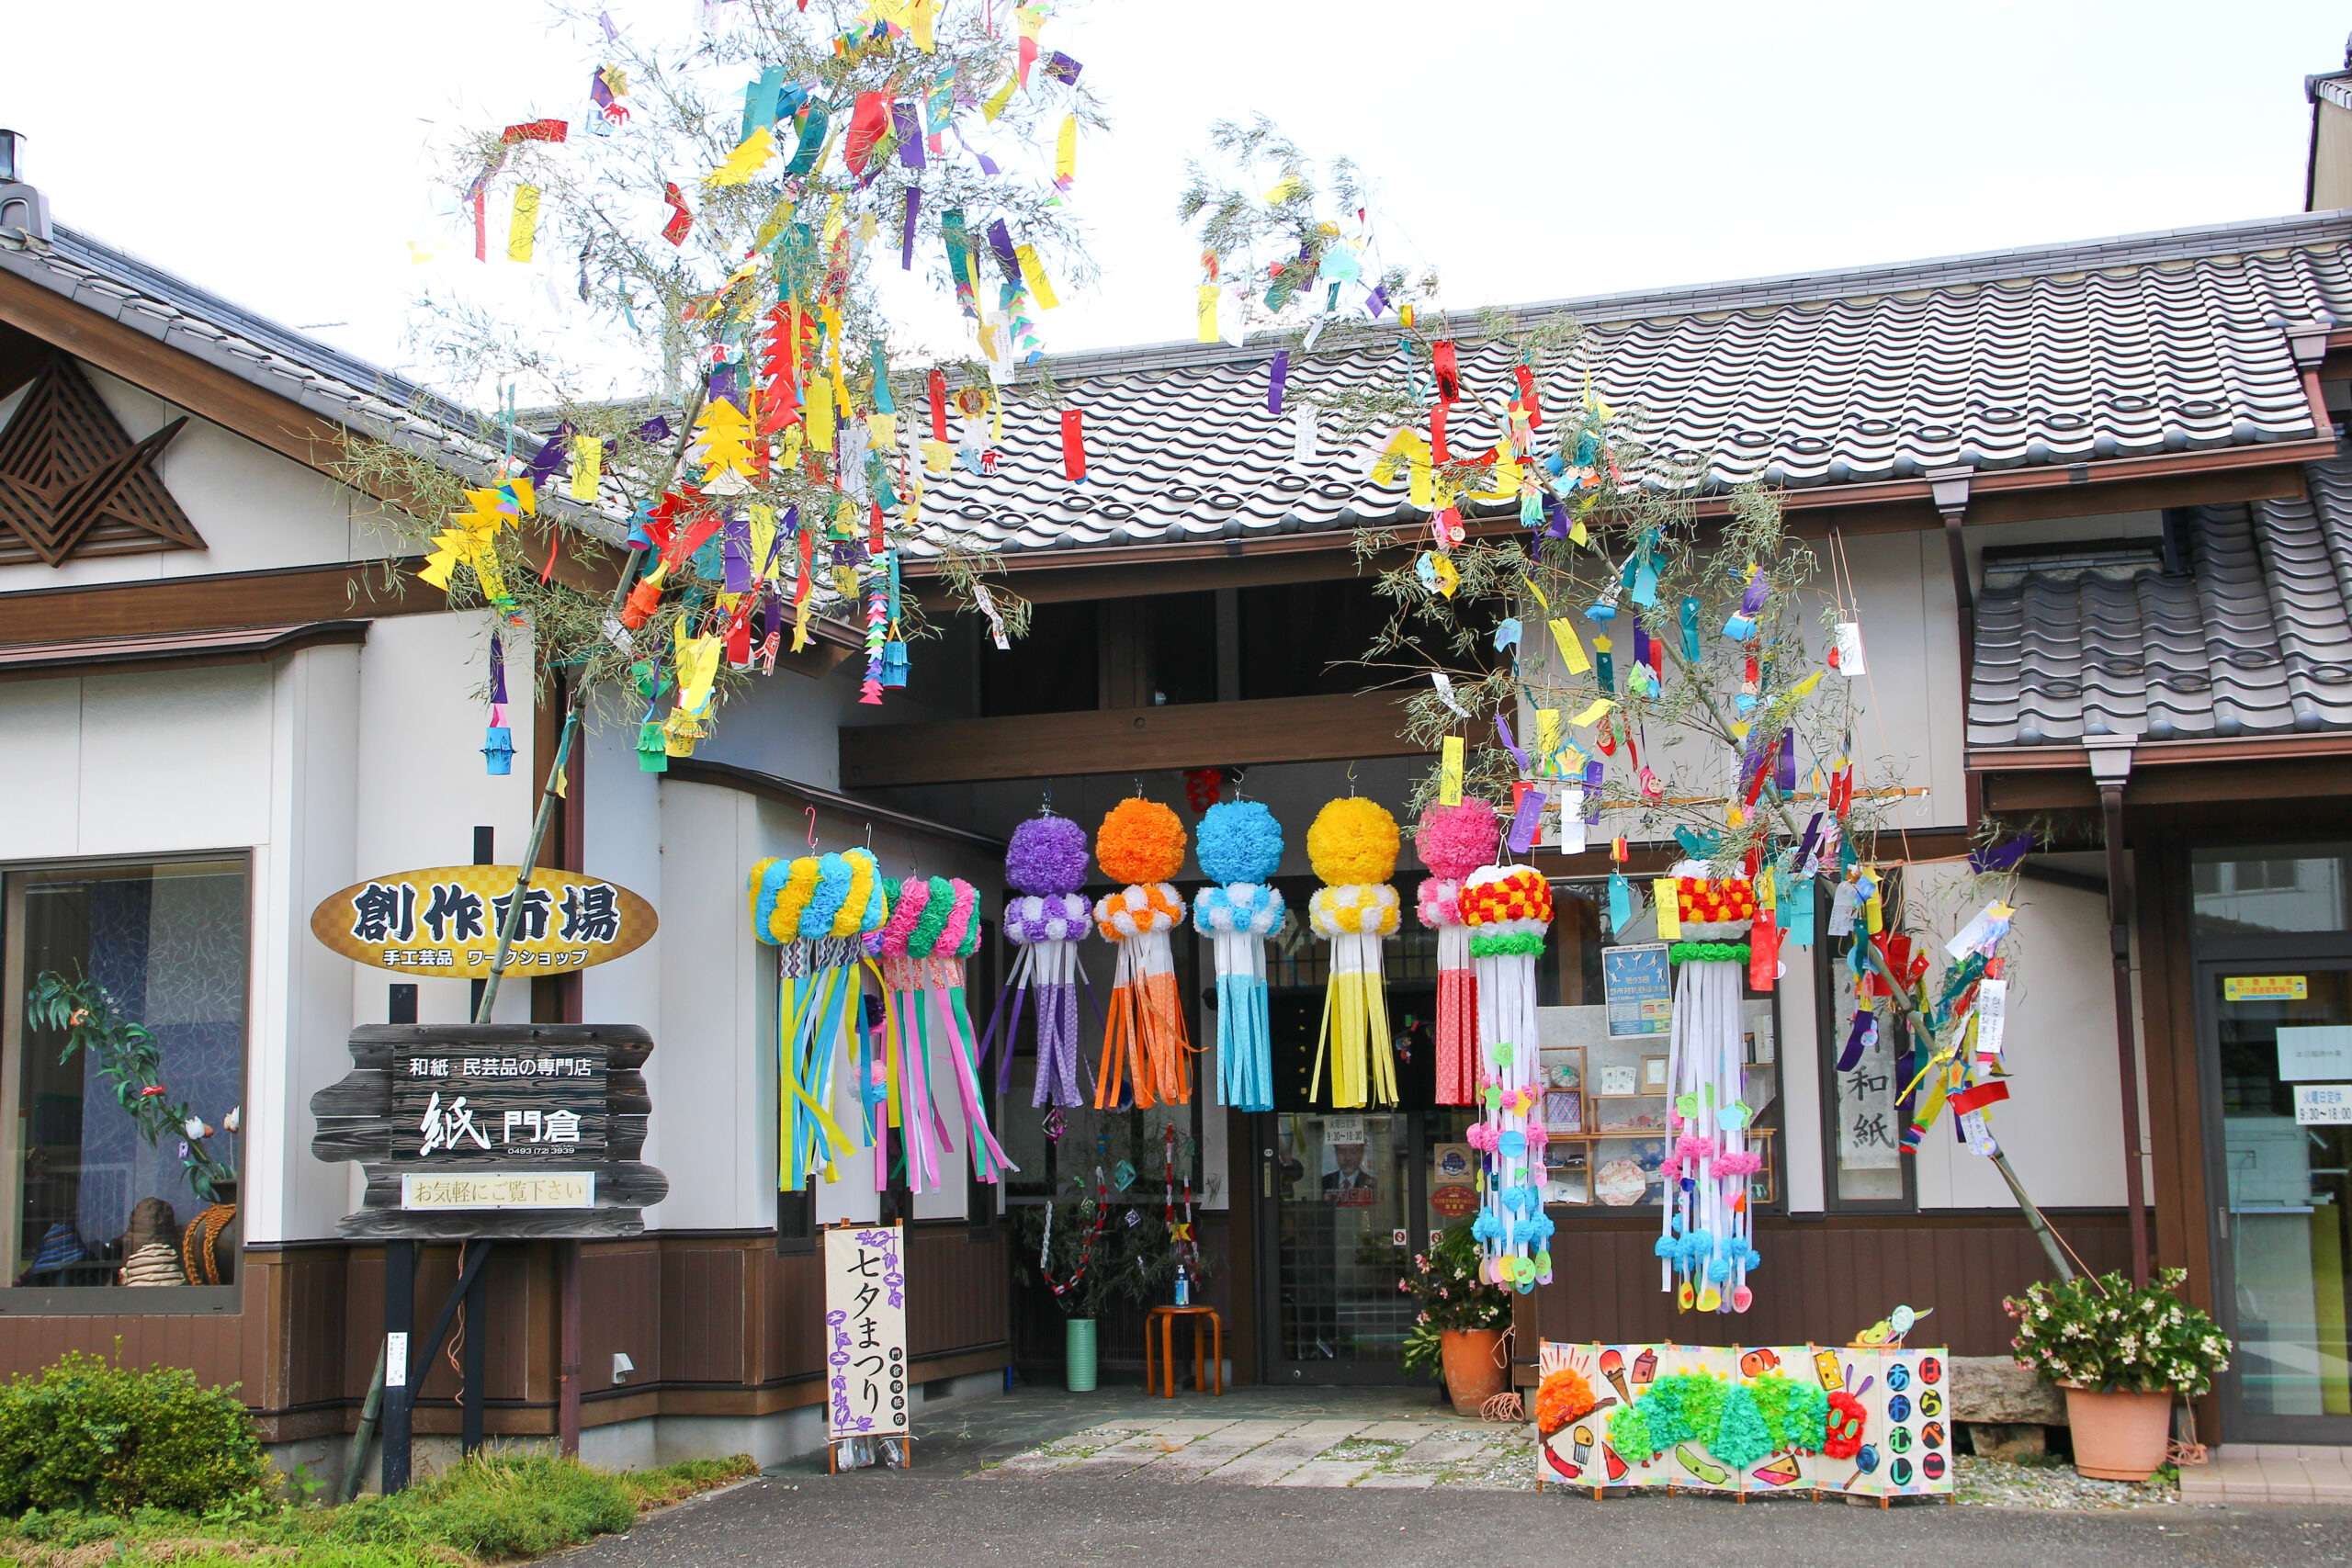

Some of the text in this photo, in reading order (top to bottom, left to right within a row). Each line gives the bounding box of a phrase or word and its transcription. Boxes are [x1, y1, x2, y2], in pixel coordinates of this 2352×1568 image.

[352, 883, 621, 942] 創作市場
[383, 948, 588, 966] 手工芸品 ワークショップ
[419, 1090, 582, 1156] 紙 門倉
[2304, 1090, 2343, 1104] 火曜日定休
[415, 1179, 582, 1203] お気軽にご覧下さい
[846, 1248, 885, 1415] 七夕まつり
[890, 1348, 906, 1426] 門倉和紙店
[1919, 1358, 1945, 1478] はらぺこ
[1887, 1364, 1912, 1484] あおむし
